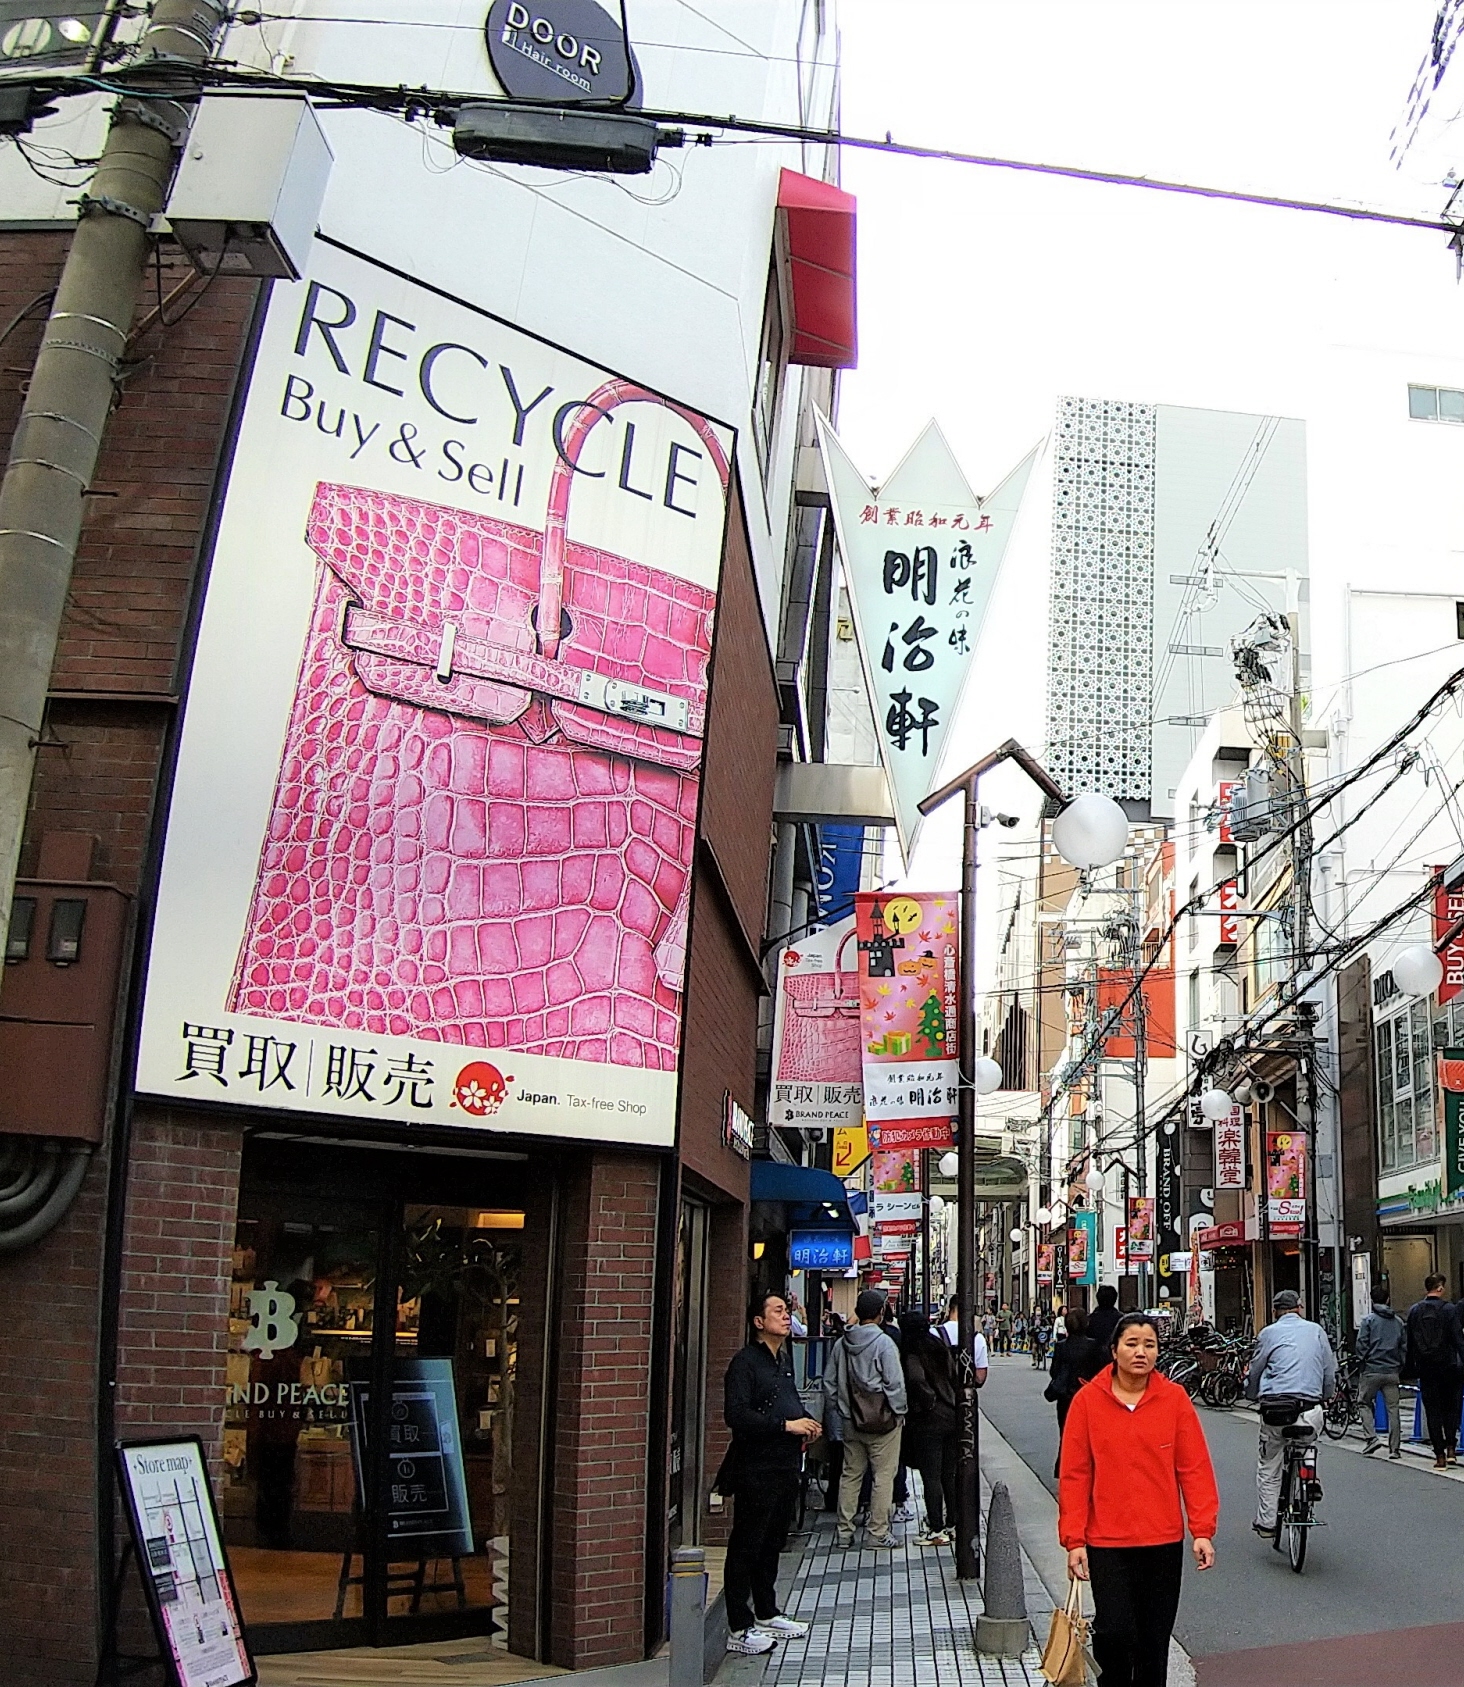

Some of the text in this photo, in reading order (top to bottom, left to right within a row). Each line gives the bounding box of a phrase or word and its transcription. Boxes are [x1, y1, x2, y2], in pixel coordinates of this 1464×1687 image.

[507, 1, 602, 74] DOOR
[522, 42, 592, 90] Hair room
[294, 280, 703, 519] RECYCLE
[280, 375, 524, 507] Buy & Sell
[858, 504, 995, 533] 創業昭和元年
[949, 538, 978, 656] 浪花の味
[883, 545, 940, 758] 明治軒
[1446, 943, 1464, 985] BUY
[175, 1021, 434, 1110] 買取 販売
[516, 1088, 648, 1117] Japan. Tax-free Shop
[775, 1085, 862, 1105] 買取 販売
[795, 1110, 849, 1119] BRAND PEACE
[909, 1087, 958, 1106] 明治軒
[882, 1126, 951, 1144] 防犯カメラ作動中
[1218, 1127, 1242, 1186] 楽韓堂
[1162, 1148, 1171, 1231] BRAND OFF
[794, 1248, 849, 1265] 明治軒
[277, 1382, 350, 1406] PEACE
[137, 1454, 189, 1476] Store map
